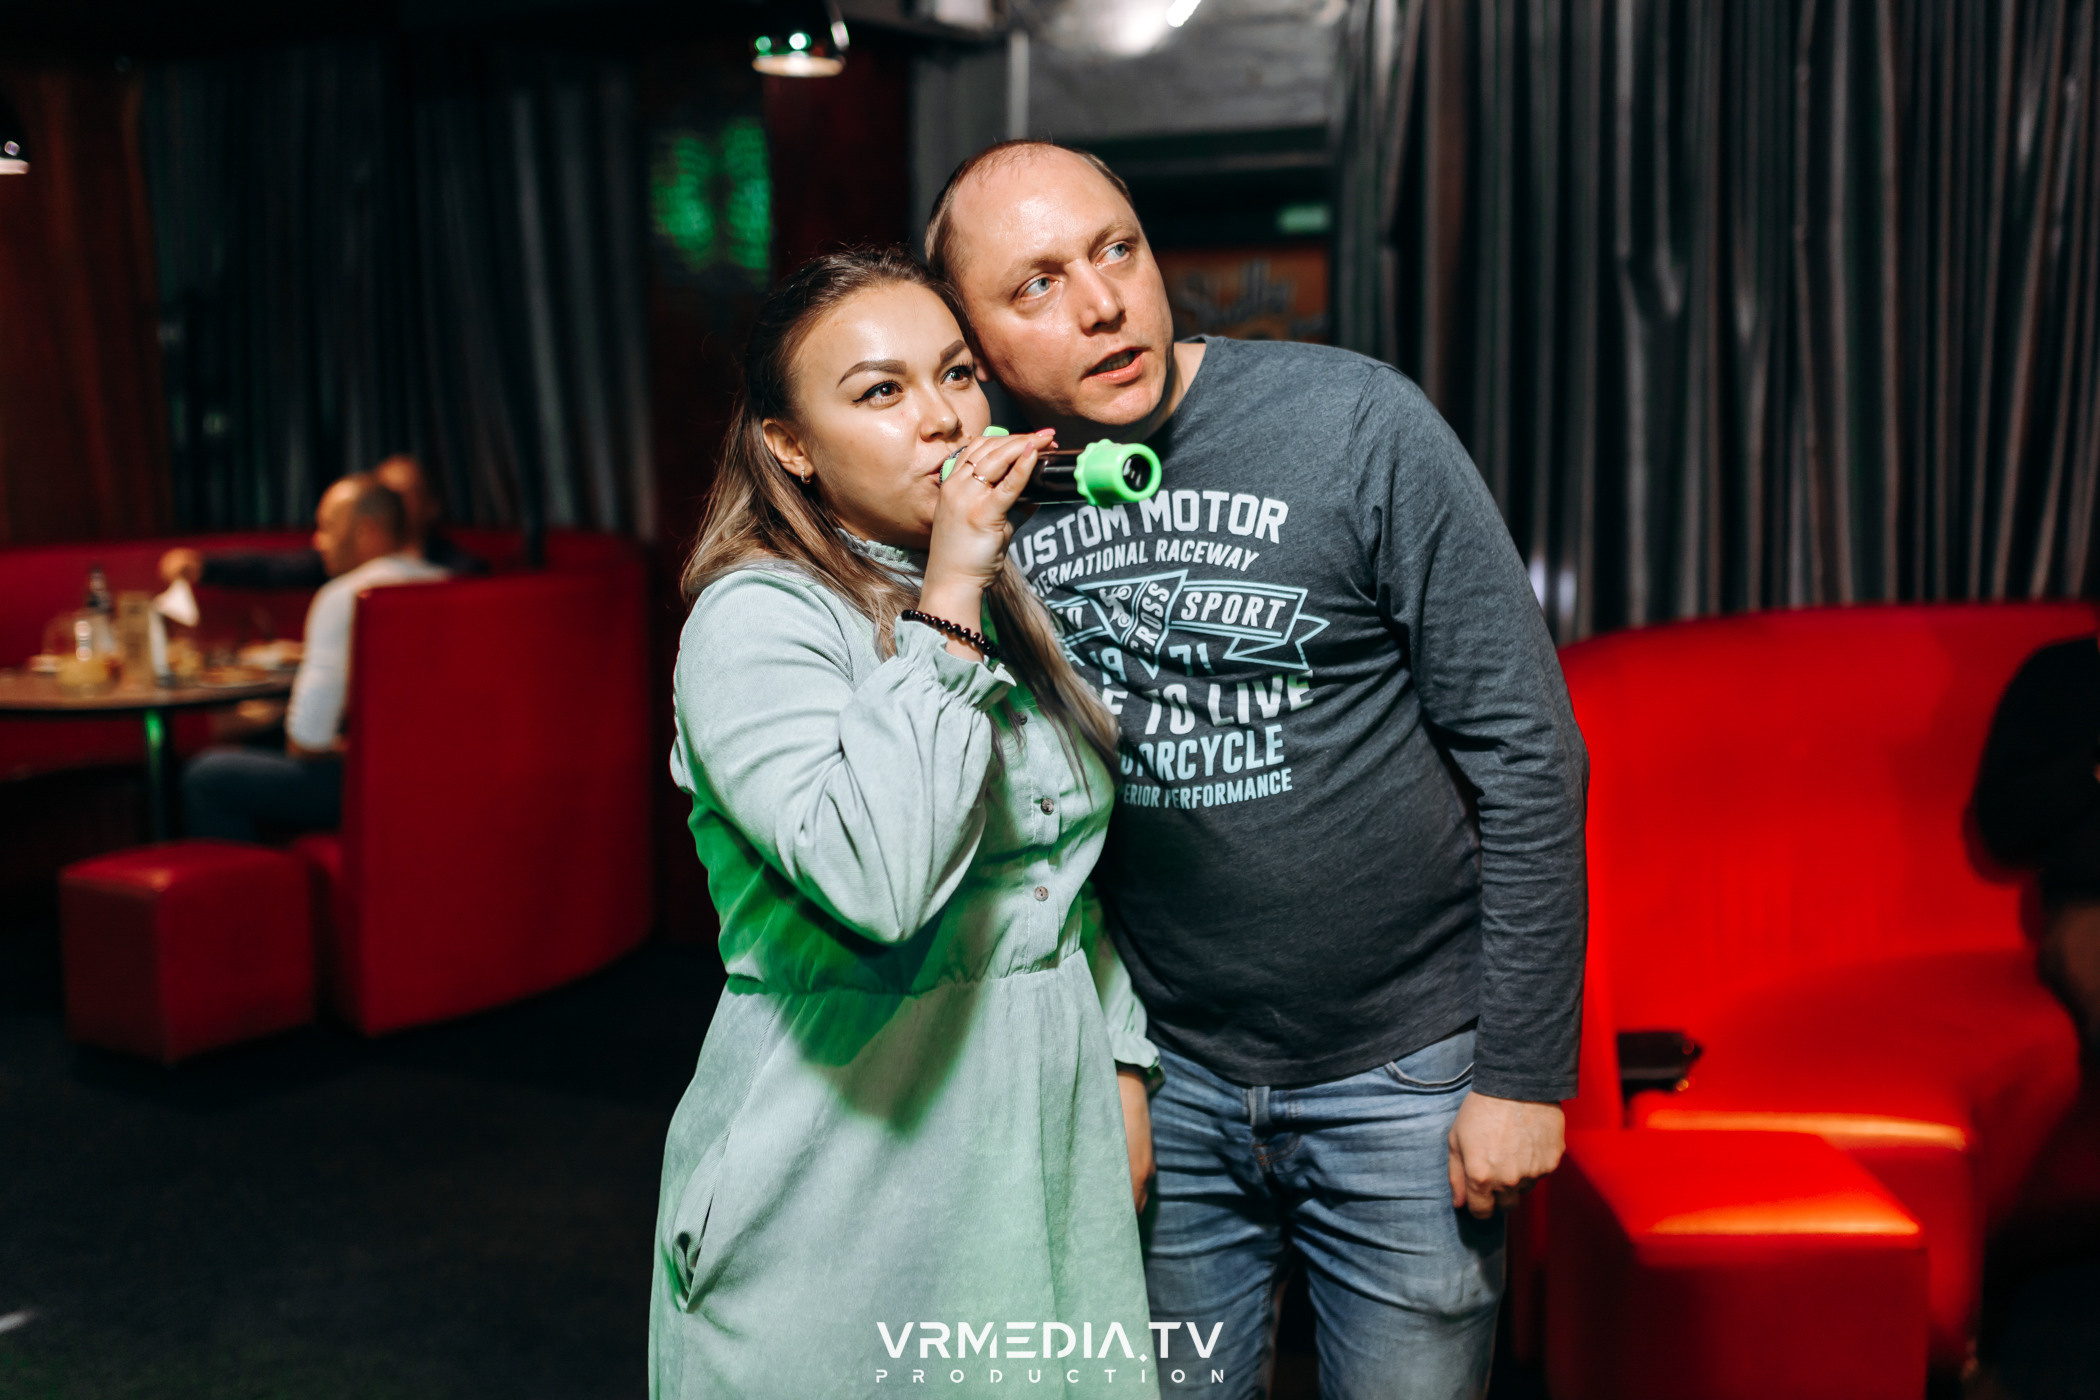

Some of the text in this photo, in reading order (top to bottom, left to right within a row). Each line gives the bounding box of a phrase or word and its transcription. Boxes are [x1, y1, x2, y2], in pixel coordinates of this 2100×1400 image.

[1009, 490, 1289, 576] USTOM MOTOR
[1030, 540, 1260, 598] TERNATIONAL RACEWAY
[1180, 591, 1286, 630] SPORT
[1208, 670, 1314, 727] LIVE
[1123, 768, 1293, 809] ERIOR PERFORMANCE
